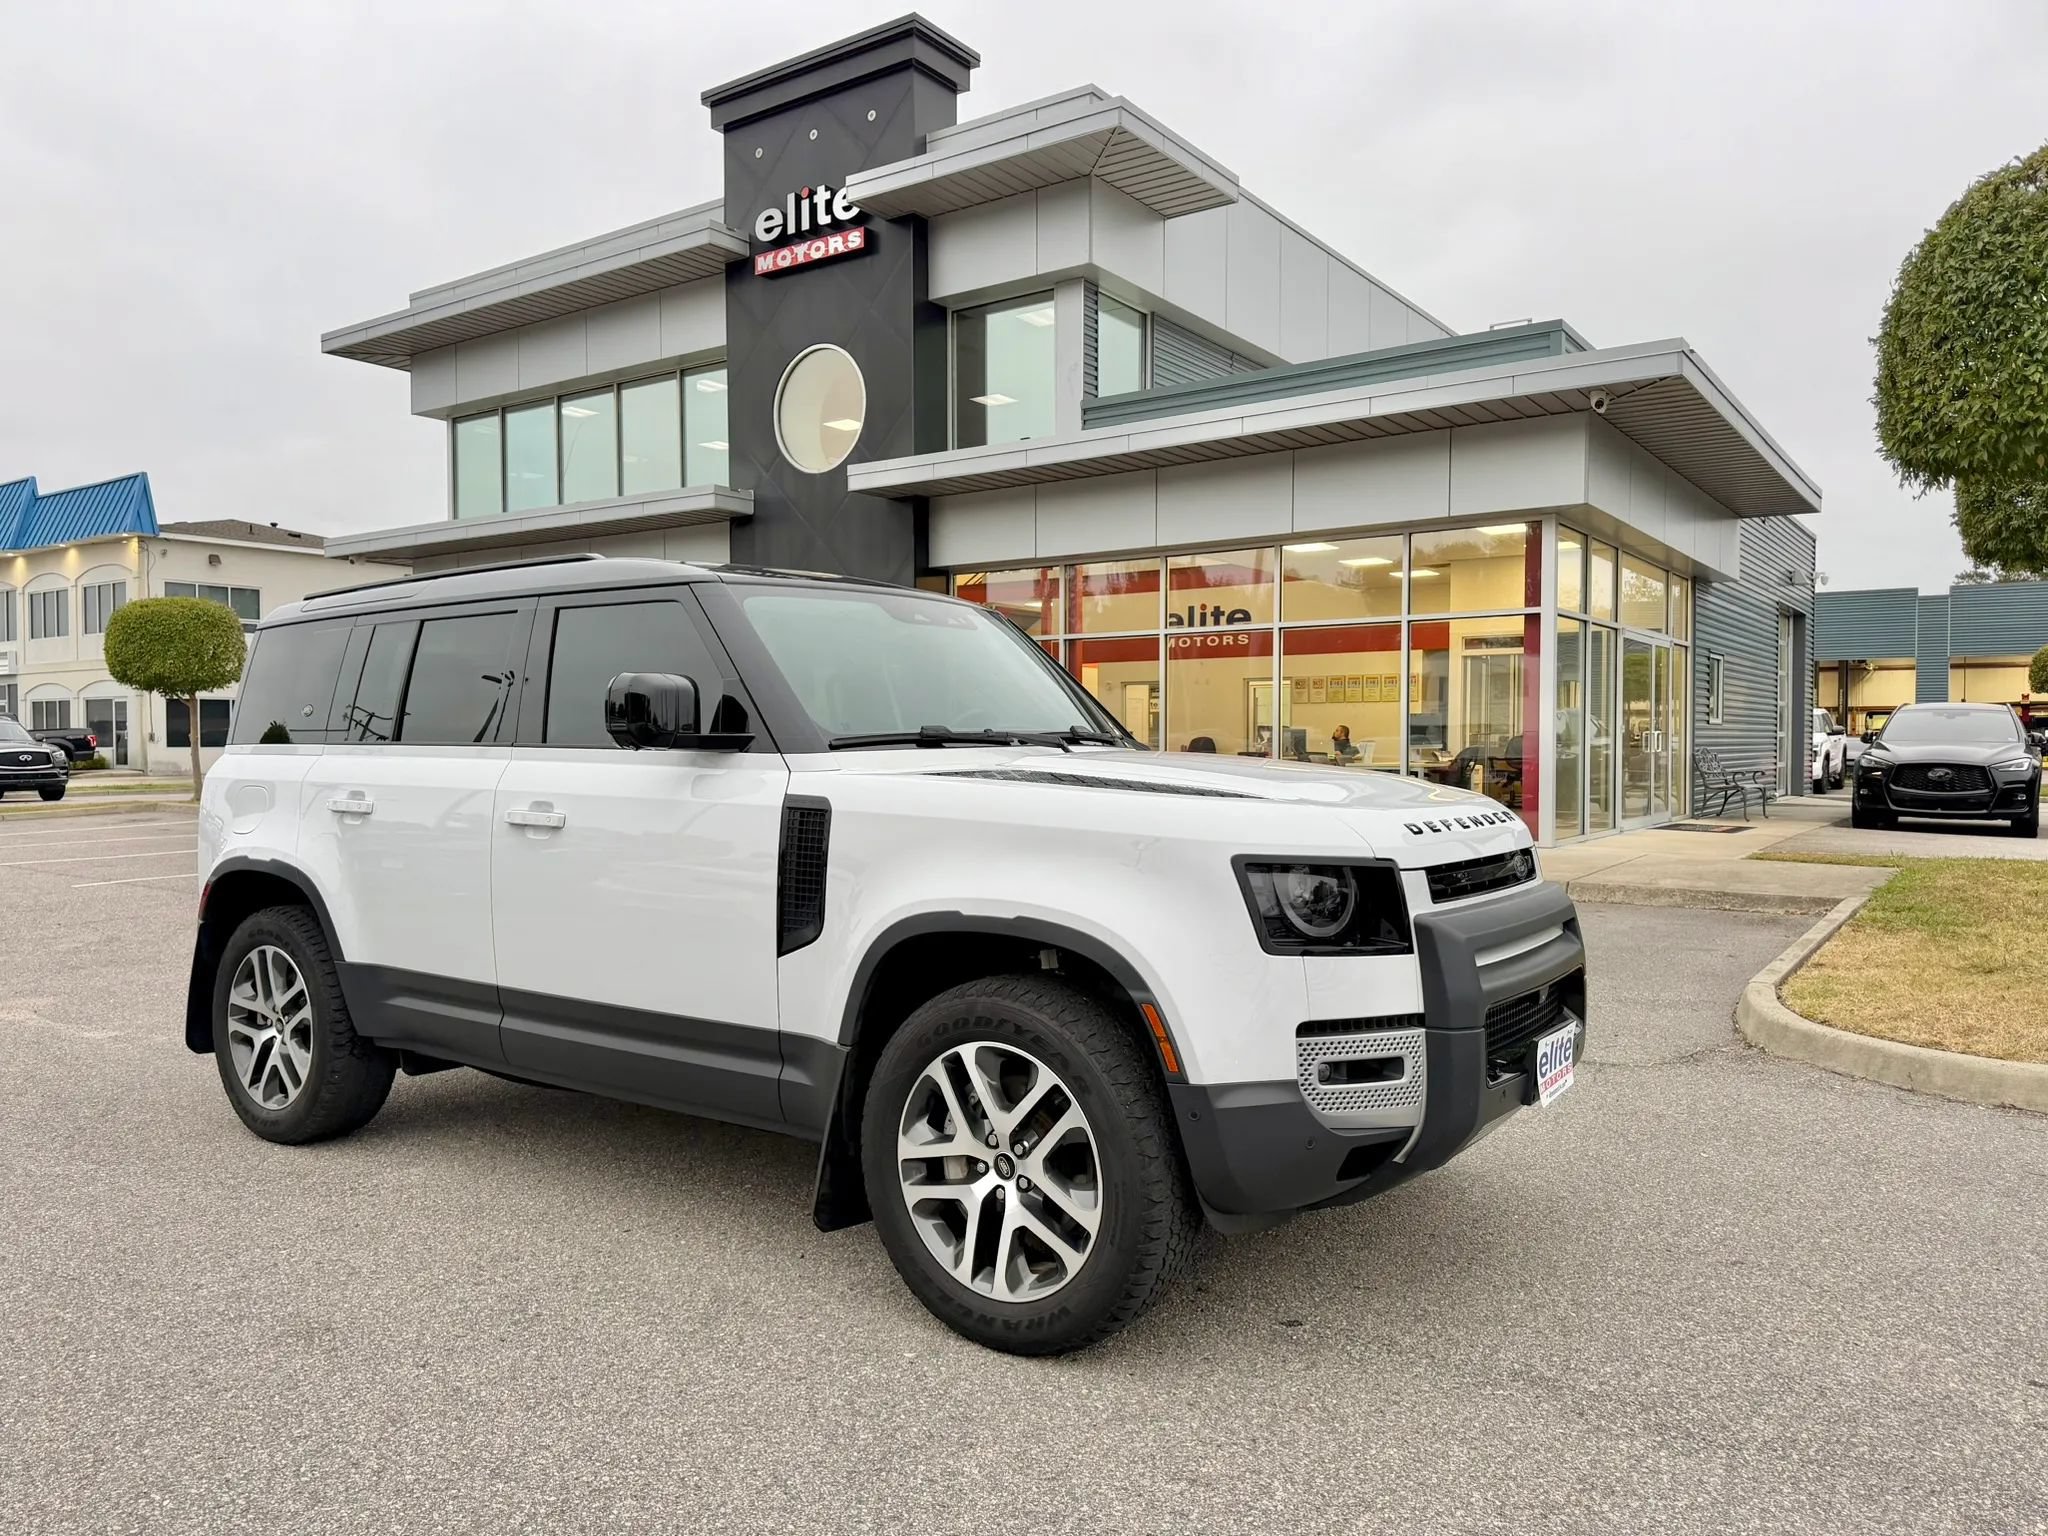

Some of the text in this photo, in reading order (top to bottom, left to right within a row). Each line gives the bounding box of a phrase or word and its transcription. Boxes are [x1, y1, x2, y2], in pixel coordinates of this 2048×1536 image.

[755, 184, 861, 242] elite
[757, 231, 862, 271] MOTORS
[1403, 811, 1516, 835] DEFENDER
[1539, 1036, 1572, 1078] elite
[1541, 1063, 1573, 1094] MOTORS
